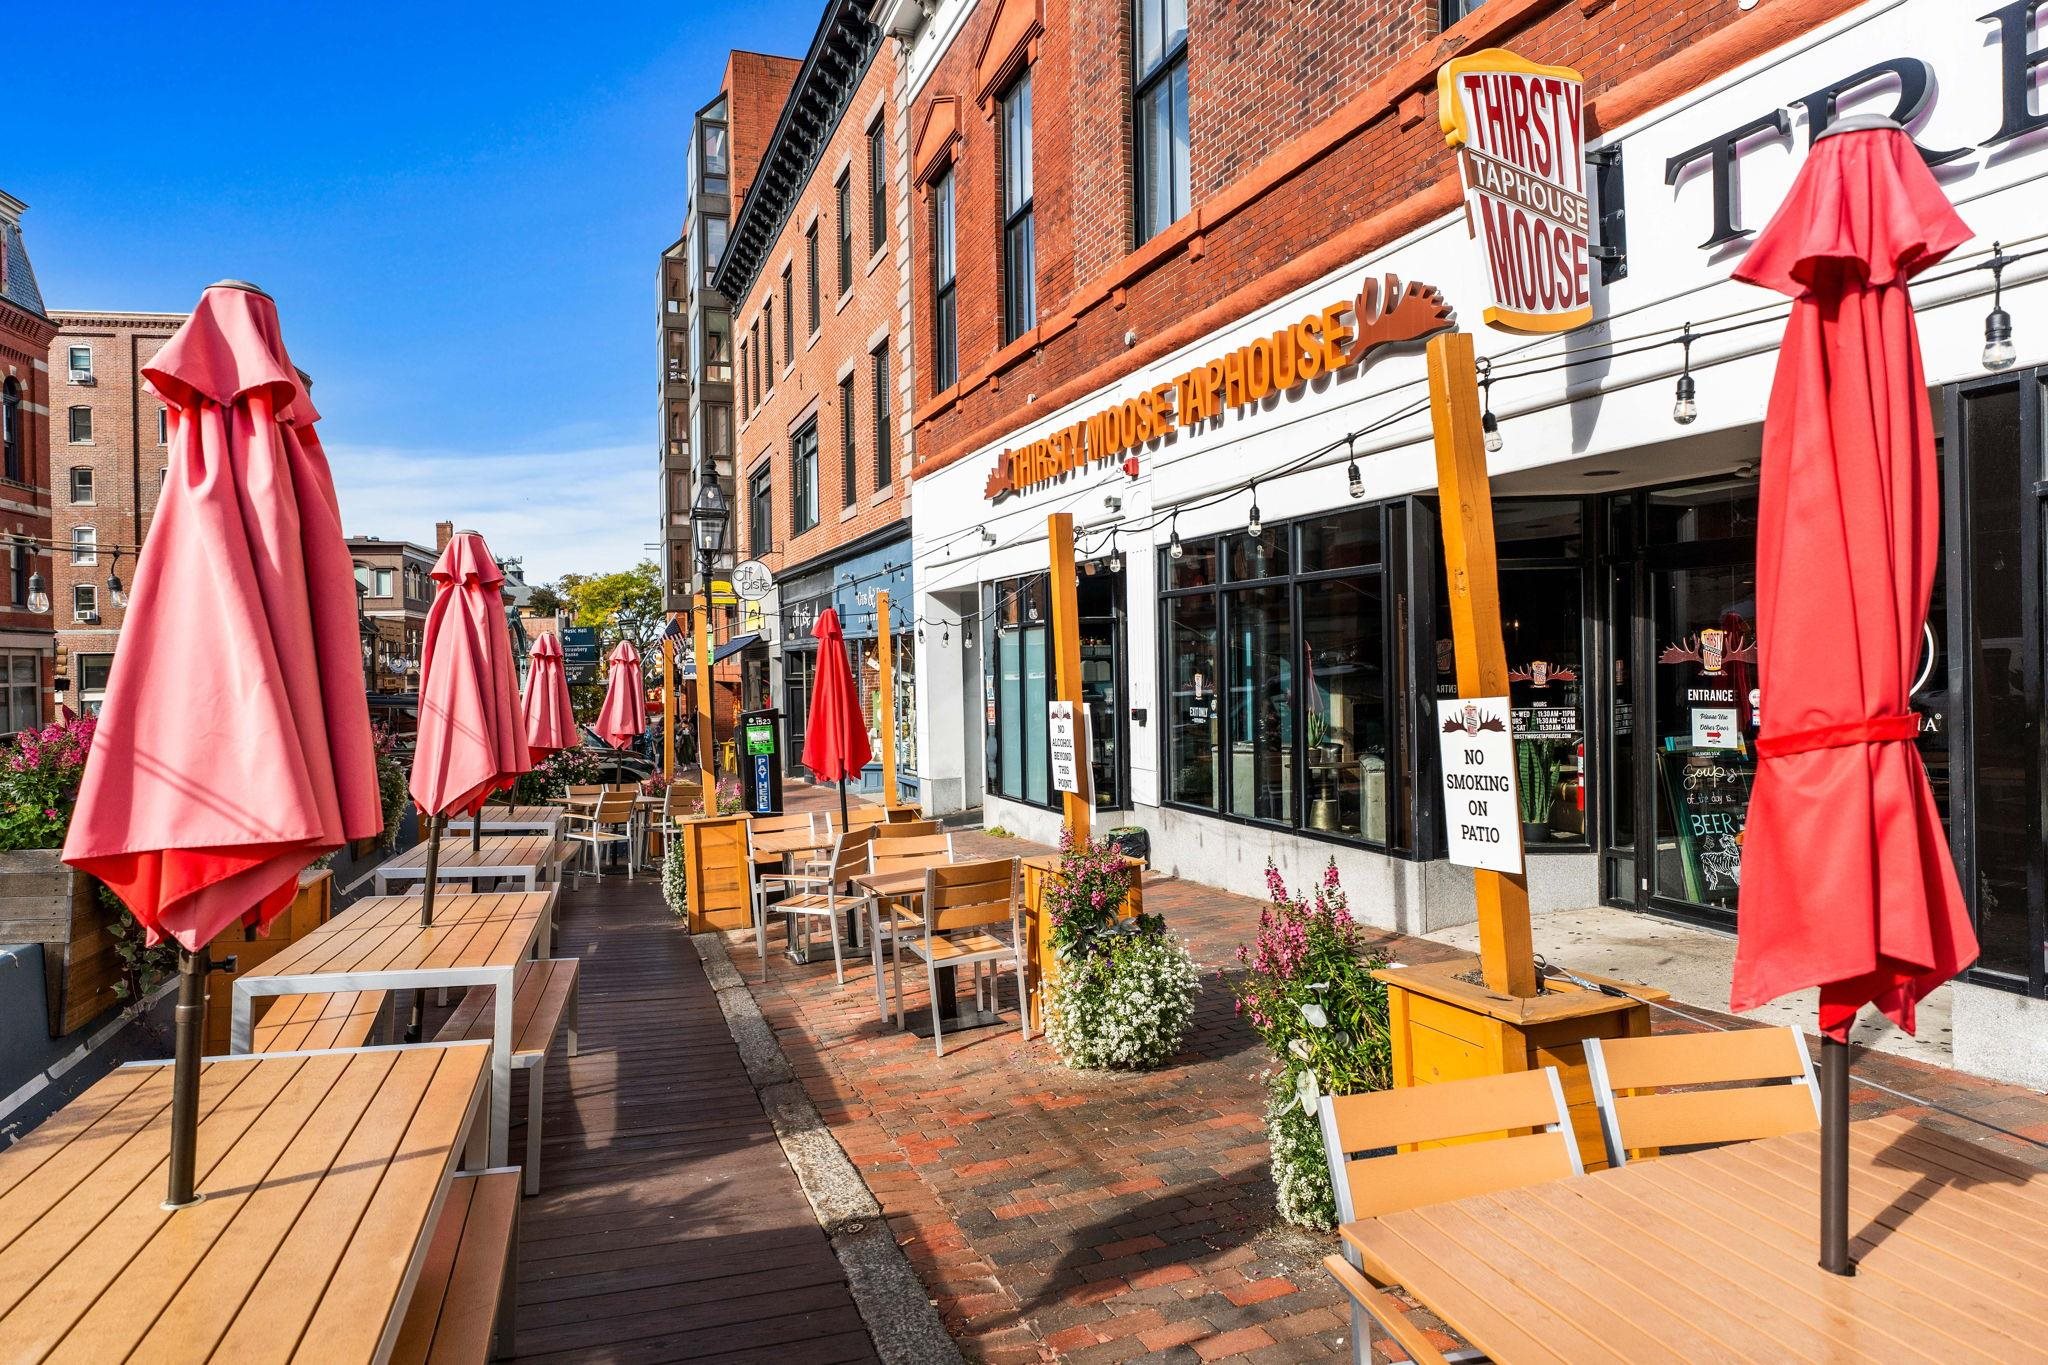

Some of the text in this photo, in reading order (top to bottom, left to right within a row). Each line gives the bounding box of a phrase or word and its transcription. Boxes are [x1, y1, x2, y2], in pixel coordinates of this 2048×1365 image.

[1464, 75, 1583, 193] THIRSTY
[1469, 155, 1588, 230] TAPHOUSE
[1480, 193, 1589, 311] MOOSE
[1010, 300, 1354, 490] THIRSTY MOOSE TAPHOUSE
[742, 576, 771, 596] piste
[1687, 689, 1734, 702] ENTRANCE
[1700, 712, 1717, 720] Please
[1057, 724, 1065, 734] NO
[1052, 738, 1072, 748] ALCOHOL
[1053, 751, 1072, 762] BEYOND
[1464, 749, 1484, 766] NO
[1058, 765, 1070, 775] THIS
[757, 758, 769, 809] PAY HERE
[1058, 778, 1072, 789] POINT
[1446, 774, 1509, 792] SMOKING
[1686, 793, 1694, 804] of
[1711, 792, 1722, 805] day
[1468, 800, 1488, 817] ON
[1690, 813, 1736, 836] BEER
[1461, 824, 1500, 843] PATIO
